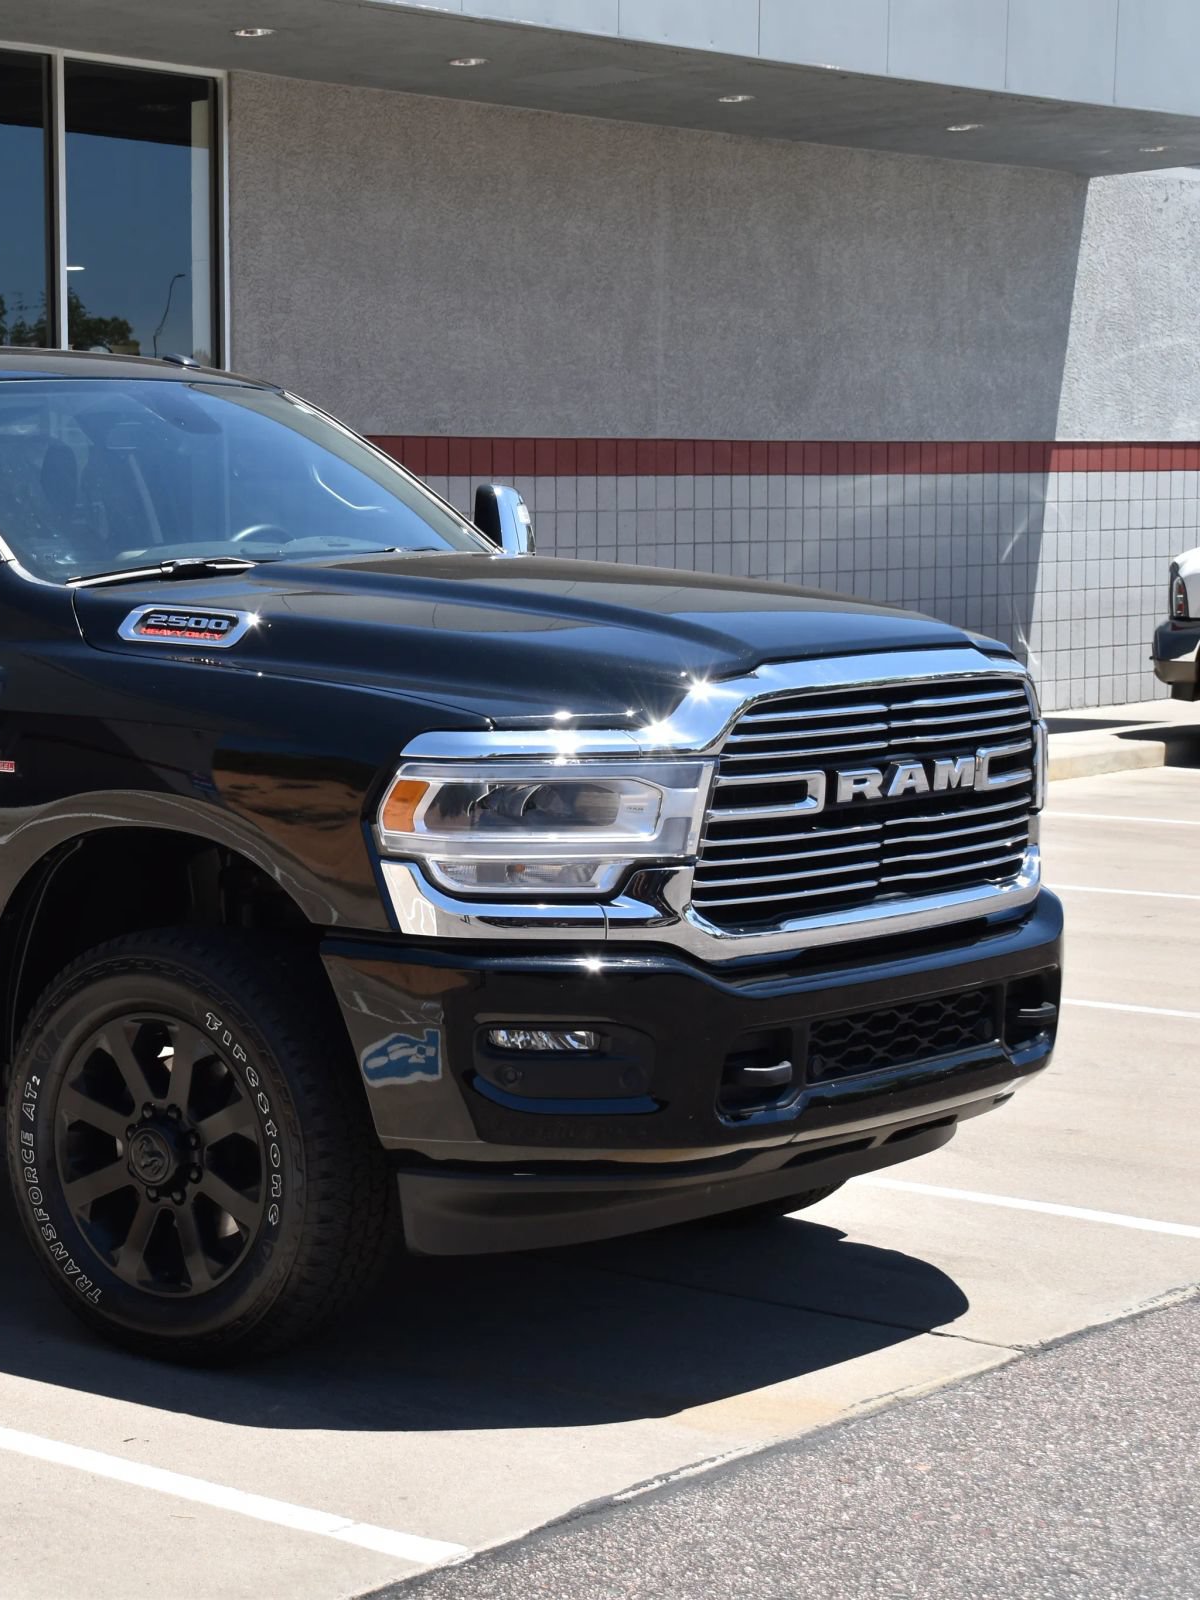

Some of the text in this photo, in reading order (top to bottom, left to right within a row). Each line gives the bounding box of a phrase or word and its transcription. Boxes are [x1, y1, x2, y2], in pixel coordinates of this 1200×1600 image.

[139, 627, 224, 641] HEAVY DUTY
[146, 614, 230, 631] 2500
[836, 755, 976, 803] RAM
[20, 1129, 103, 1304] TRANSFORCE
